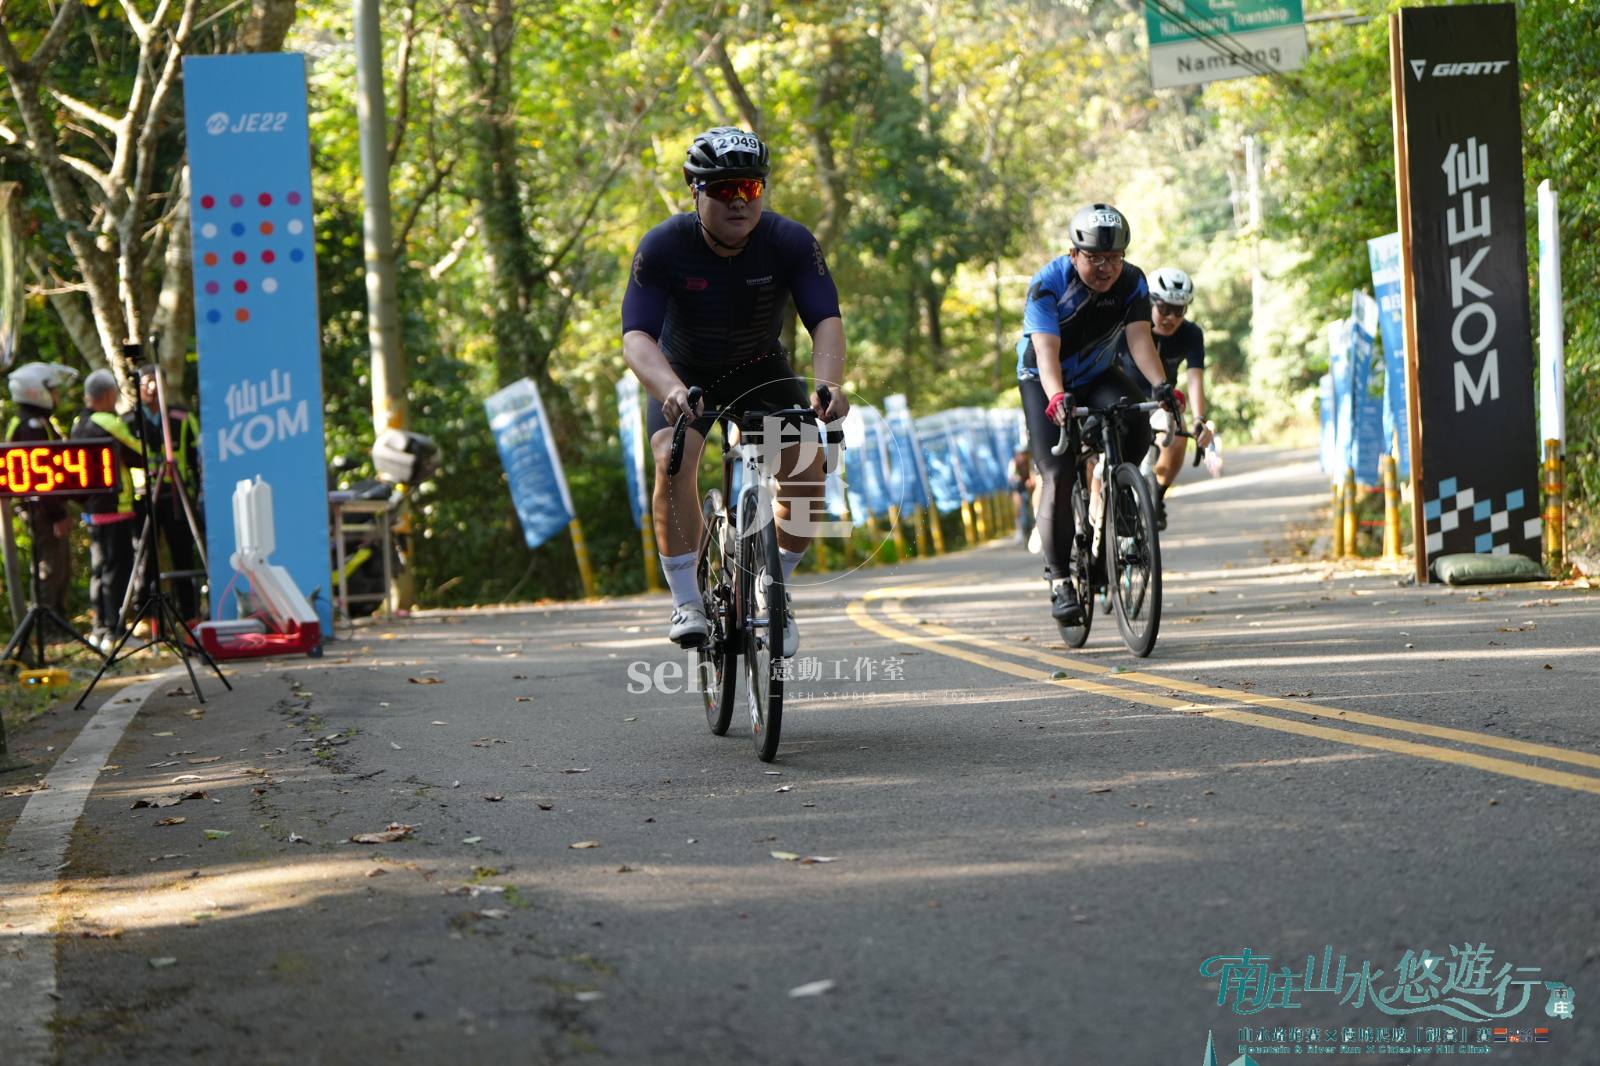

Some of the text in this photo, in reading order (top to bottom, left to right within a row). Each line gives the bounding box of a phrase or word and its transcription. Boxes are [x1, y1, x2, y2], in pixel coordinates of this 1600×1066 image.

[1431, 59, 1511, 78] GIANT
[231, 111, 289, 134] JE22
[224, 368, 293, 421] 仙山
[217, 399, 310, 462] KOM
